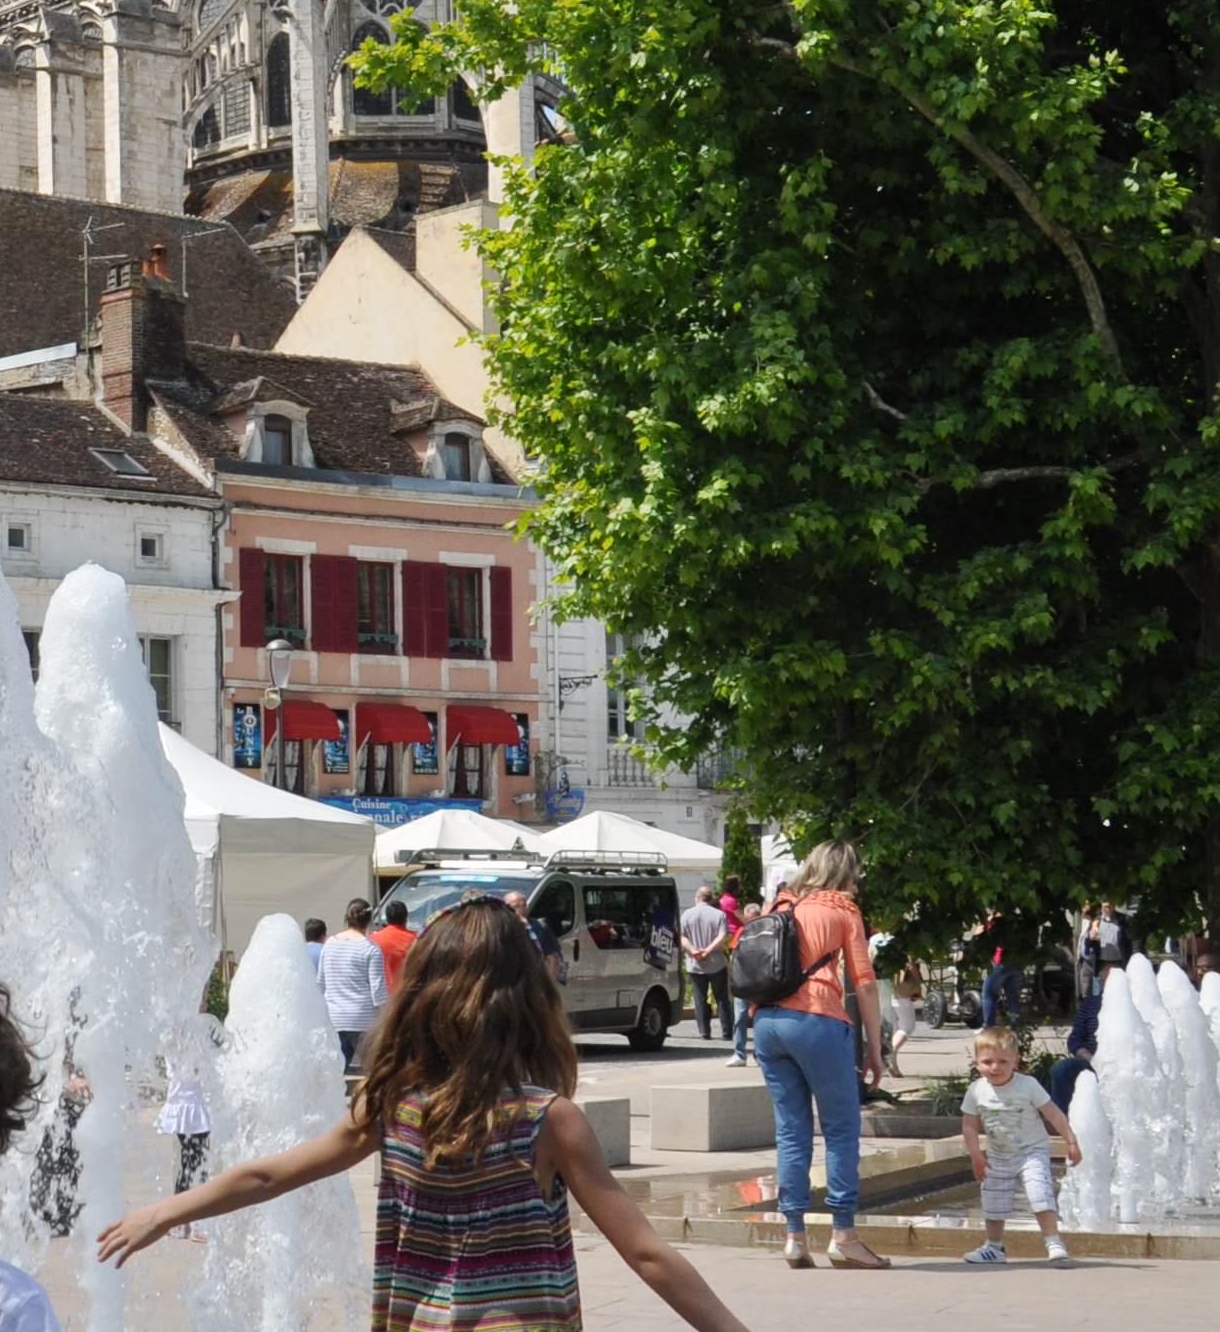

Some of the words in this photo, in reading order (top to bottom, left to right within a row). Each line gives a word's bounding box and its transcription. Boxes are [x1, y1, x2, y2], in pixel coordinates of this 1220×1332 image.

[243, 705, 258, 767] BOUNTY
[352, 797, 392, 810] Cuisine
[650, 924, 674, 954] bleu
